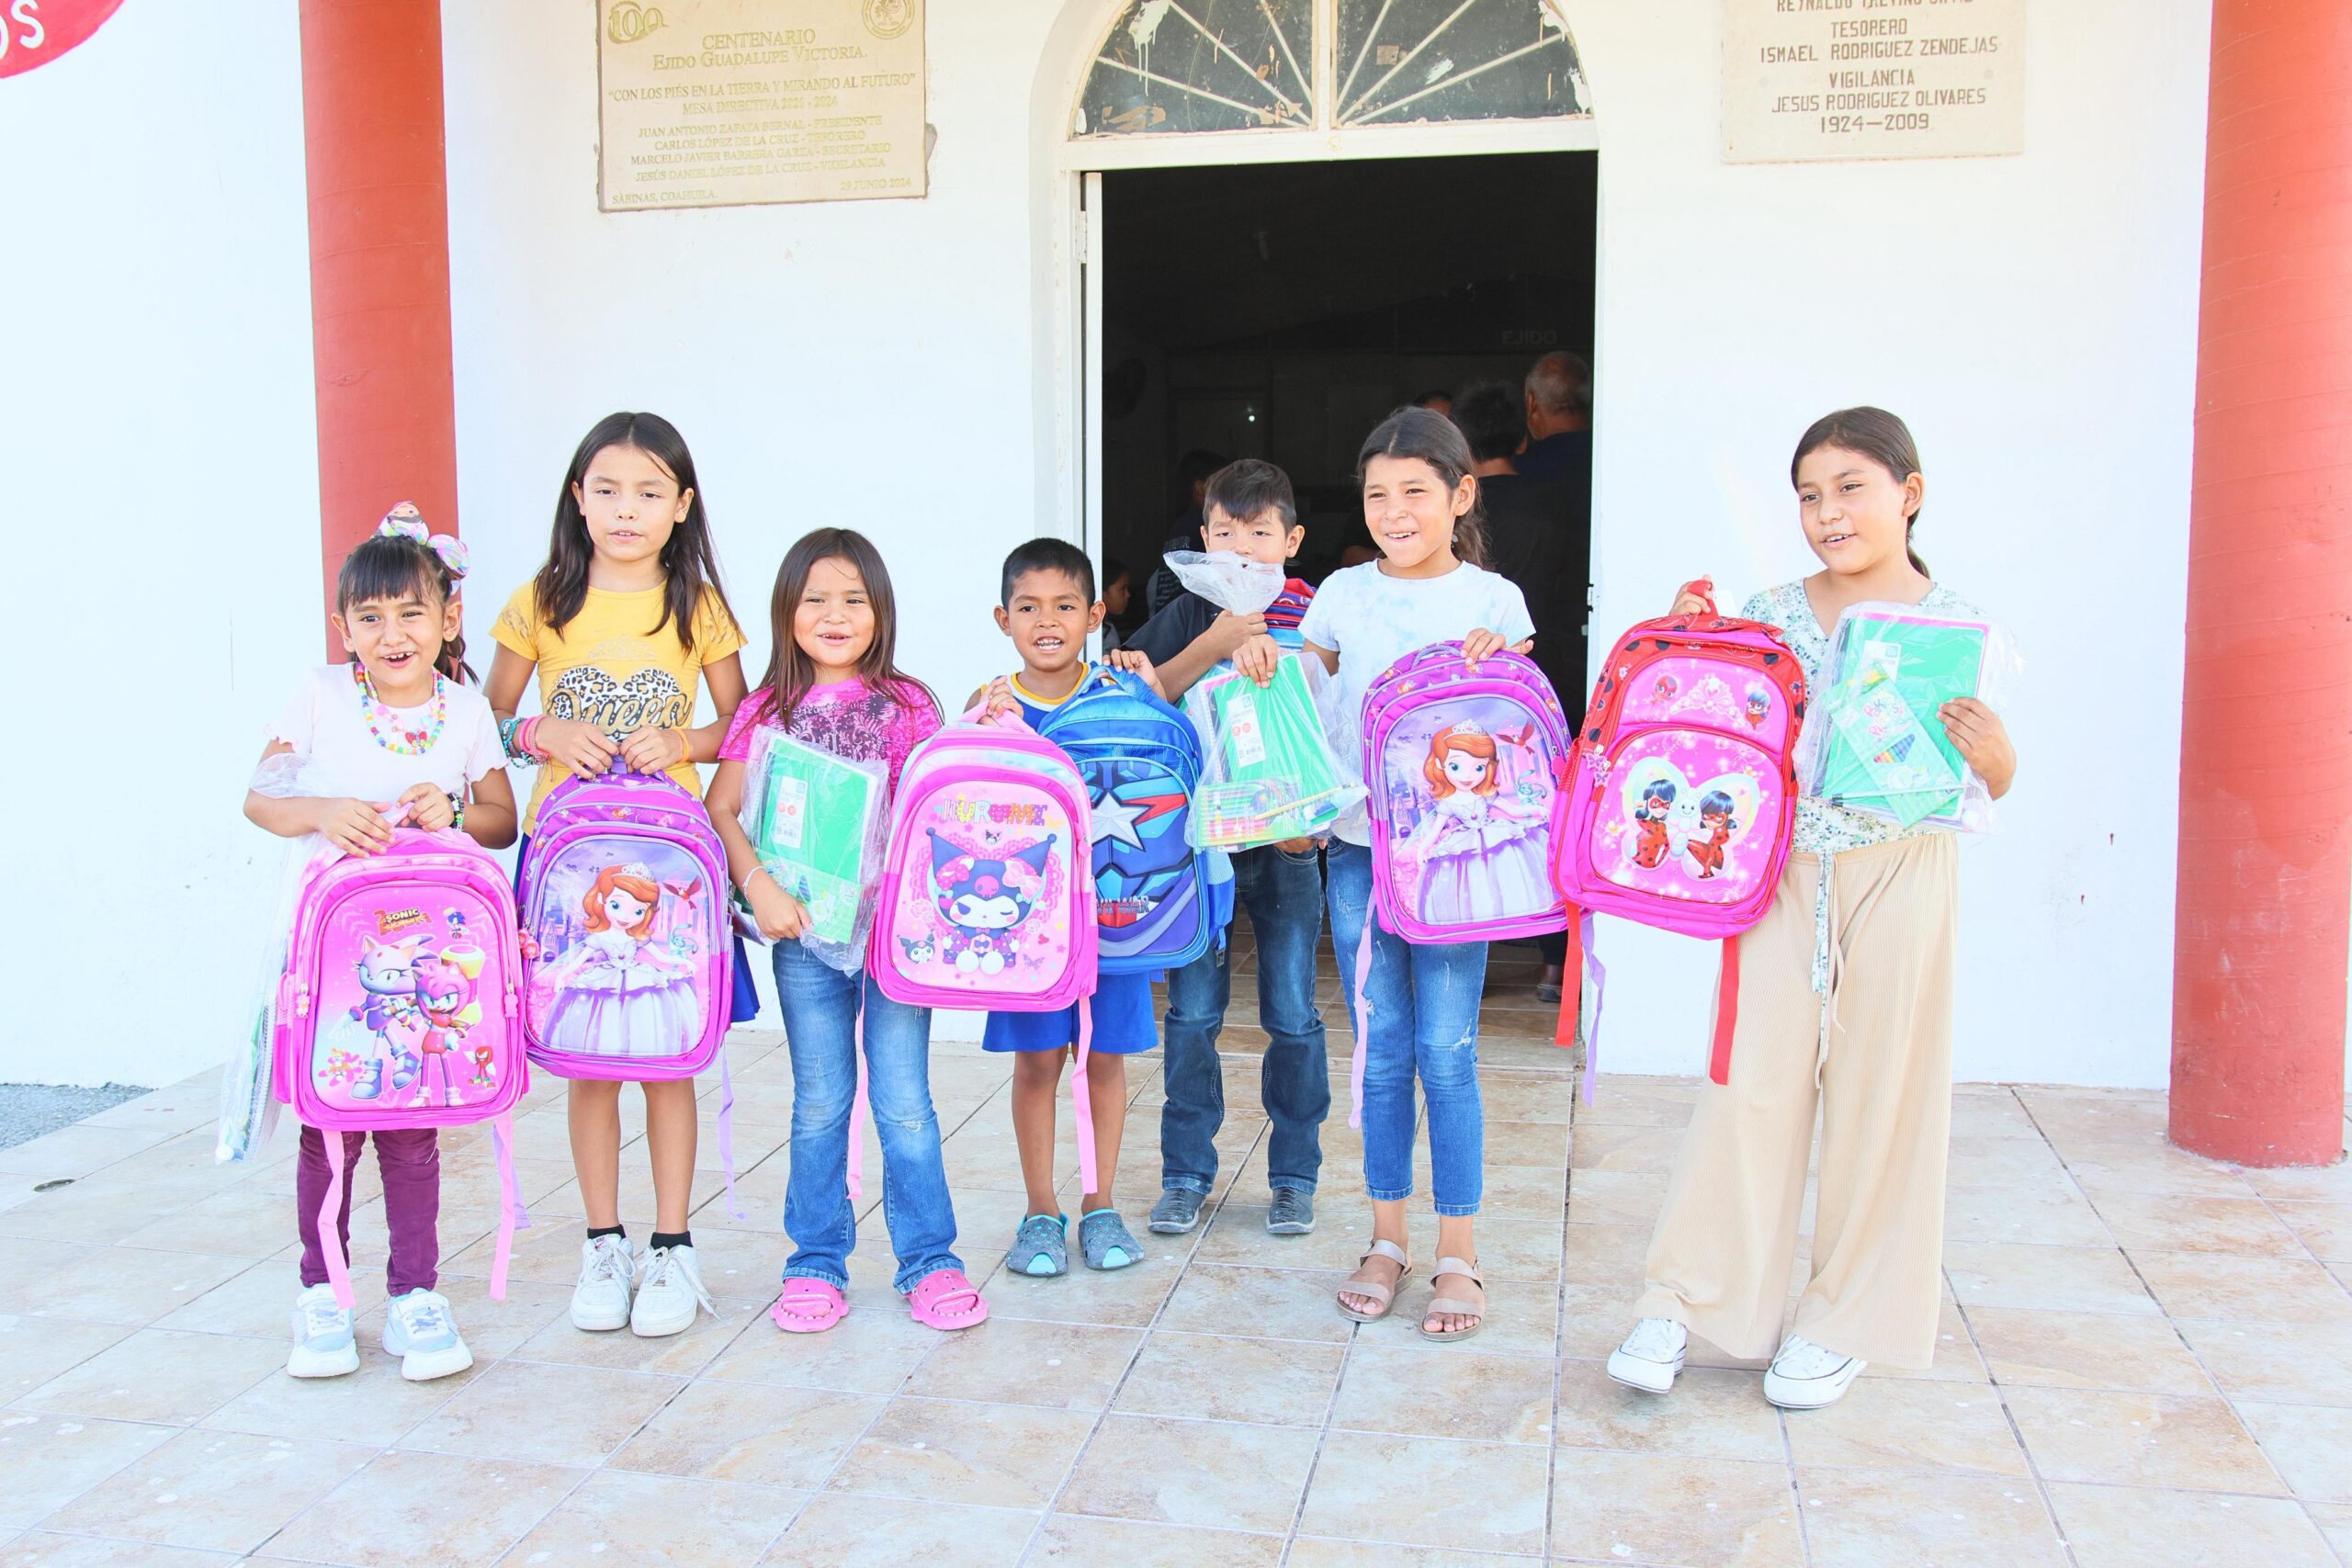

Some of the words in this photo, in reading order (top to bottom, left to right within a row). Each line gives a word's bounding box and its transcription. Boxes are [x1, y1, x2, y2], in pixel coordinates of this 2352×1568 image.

[0, 0, 45, 59] S
[1830, 18, 1908, 39] TESORERO
[702, 28, 817, 51] CENTENARIO
[1760, 46, 1819, 63] ISMAEL
[1830, 40, 1914, 61] RODRIGUEZ
[1919, 36, 1998, 56] ZENDEJAS
[653, 54, 696, 71] EJIDO
[701, 51, 789, 68] GUADALUPE
[792, 46, 867, 62] VICTORIA.
[640, 87, 662, 100] LOS
[691, 85, 709, 97] EN
[710, 85, 724, 96] LA
[727, 82, 770, 95] TIERRA
[773, 80, 781, 92] Y
[784, 78, 841, 91] MIRANDO
[842, 76, 859, 88] AL
[1828, 69, 1916, 89] VIGILANCIA
[683, 102, 713, 115] MESA
[717, 98, 779, 114] DIRECTIVA
[1772, 95, 1820, 113] JESUS
[1826, 91, 1909, 111] RODRIGUEZ
[1915, 88, 1986, 107] OLIVARES
[639, 127, 665, 138] JUAN
[668, 125, 717, 137] ANTONIO
[813, 116, 883, 129] PRESIDENTE
[654, 140, 697, 151] CARLOS
[734, 137, 751, 147] DE
[752, 136, 766, 145] LA
[769, 134, 799, 145] CRUZ
[631, 153, 682, 165] MARCELO
[684, 152, 721, 164] JAVIER
[669, 167, 709, 180] DANIEL
[764, 164, 781, 174] LA
[1502, 329, 1558, 346] EJIDO
[547, 688, 693, 736] Queen
[386, 907, 420, 924] SONIC
